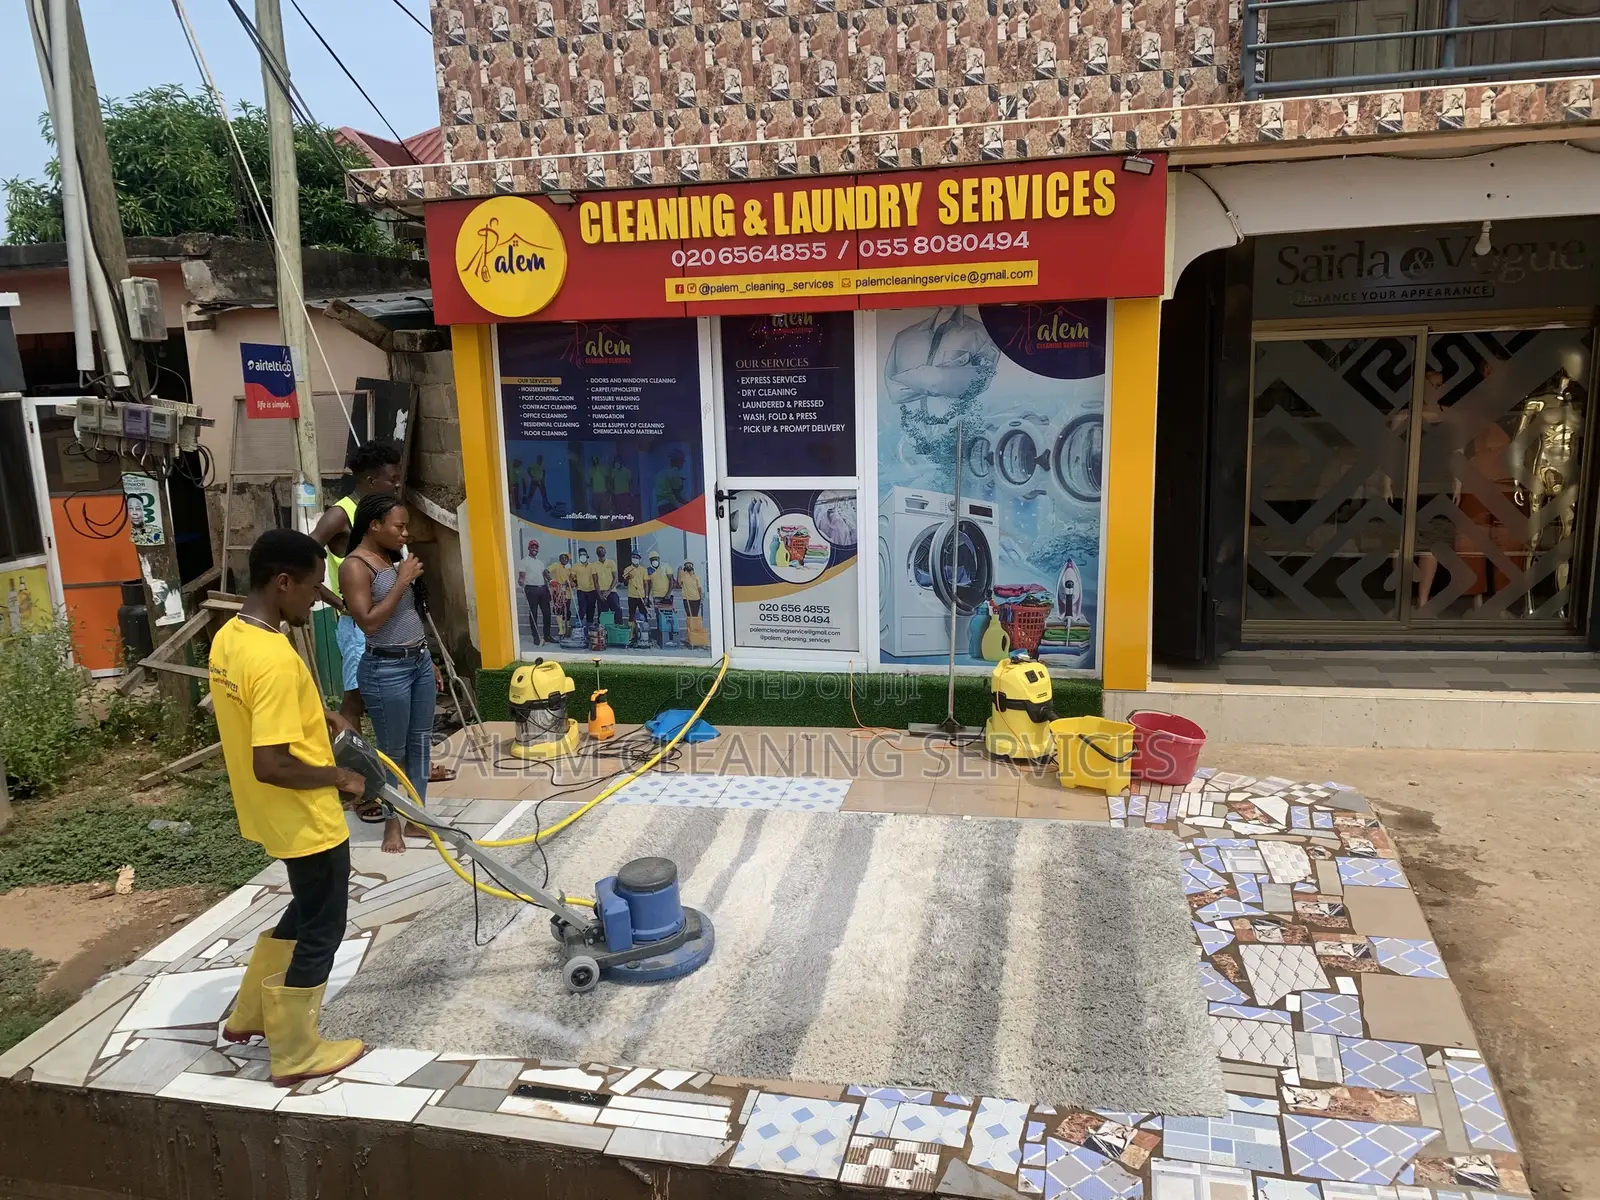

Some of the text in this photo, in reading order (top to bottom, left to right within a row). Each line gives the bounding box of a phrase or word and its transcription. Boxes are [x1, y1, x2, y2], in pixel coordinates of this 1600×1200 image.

[579, 169, 1116, 245] CLEANING & LAUNDRY SERVICES
[698, 268, 1033, 296] @palem_cleaning_services palemcleaningservice@gmail.com
[1361, 290, 1396, 300] YOUR
[1400, 285, 1489, 299] APPEARANCE
[735, 357, 809, 369] OUR SERVICES
[740, 375, 807, 385] EXPRESS SERVICES
[741, 388, 797, 397] DRY CLEANING
[257, 400, 266, 410] life
[742, 400, 785, 409] LAUNDERED
[793, 399, 824, 408] PRESSED
[742, 411, 818, 422] WASH, FOLD & PRESS
[743, 423, 846, 433] PICK UP & PROMPT DELIVERY
[611, 513, 634, 522] priority
[758, 603, 830, 613] 020 656 4855
[759, 613, 830, 624] 055 808 0494
[749, 627, 840, 636] palemcleaningservice@gmail.com
